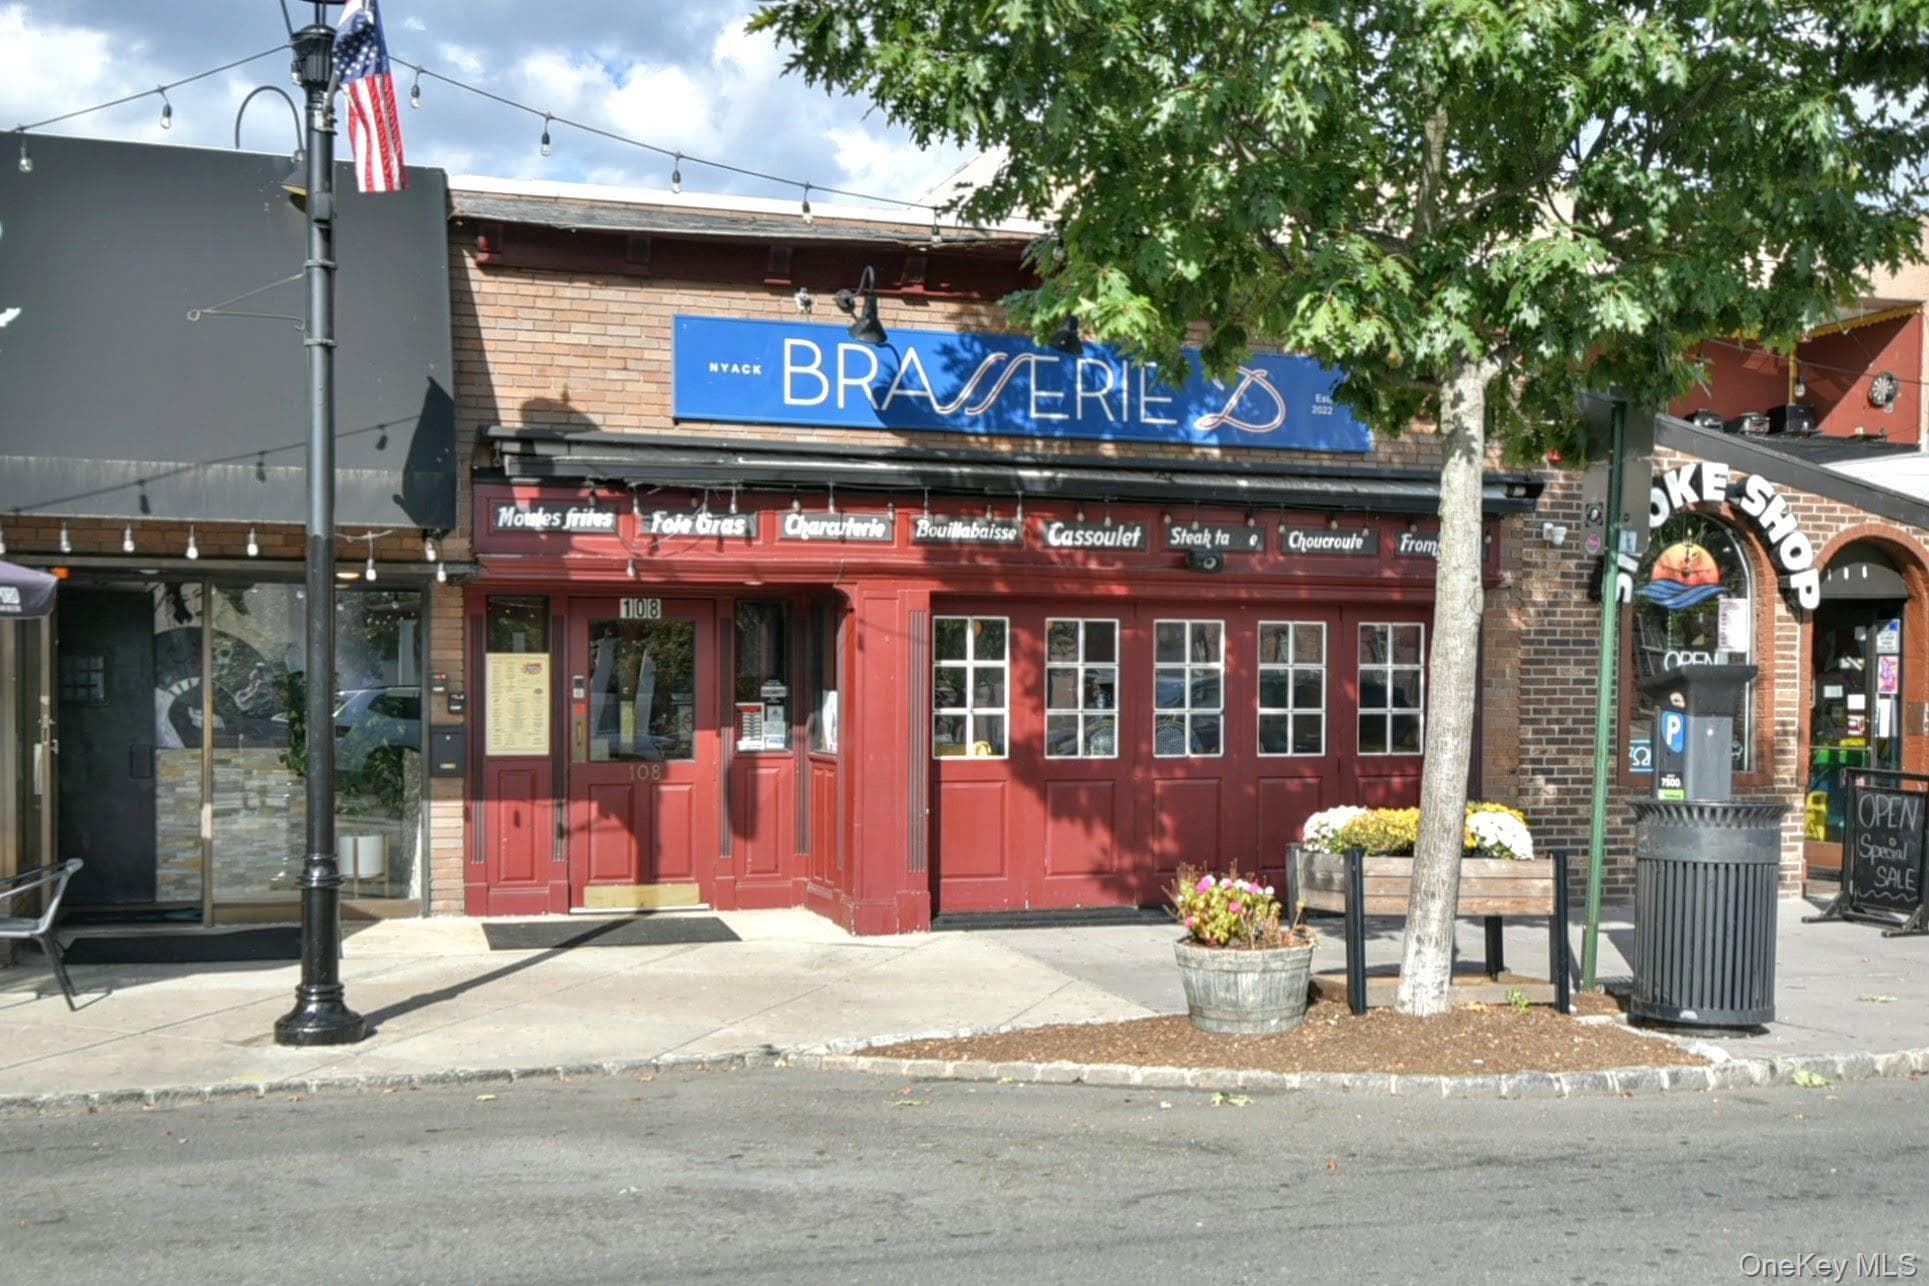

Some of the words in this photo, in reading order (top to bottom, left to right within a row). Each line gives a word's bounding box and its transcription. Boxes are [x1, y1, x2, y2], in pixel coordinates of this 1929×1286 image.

[708, 362, 762, 375] NYACK
[783, 337, 1178, 424] BRASSERIE
[1311, 405, 1333, 415] 2022
[498, 507, 561, 528] Moules
[562, 507, 614, 530] frites
[650, 511, 692, 535] Foie
[695, 512, 746, 535] Gras
[784, 513, 886, 540] Charcuterie
[916, 518, 1017, 541] Bouillabaisse
[1049, 522, 1142, 547] Cassoulet
[1170, 527, 1211, 548] Steak
[1288, 530, 1364, 553] Choucroute
[1400, 533, 1441, 556] From
[1740, 474, 1820, 610] SHOP
[623, 600, 660, 618] 108
[1664, 650, 1718, 672] OPEN
[628, 764, 662, 781] 108
[1858, 793, 1919, 831] OPEN
[1859, 833, 1907, 866] Special
[1873, 865, 1917, 892] SALE
